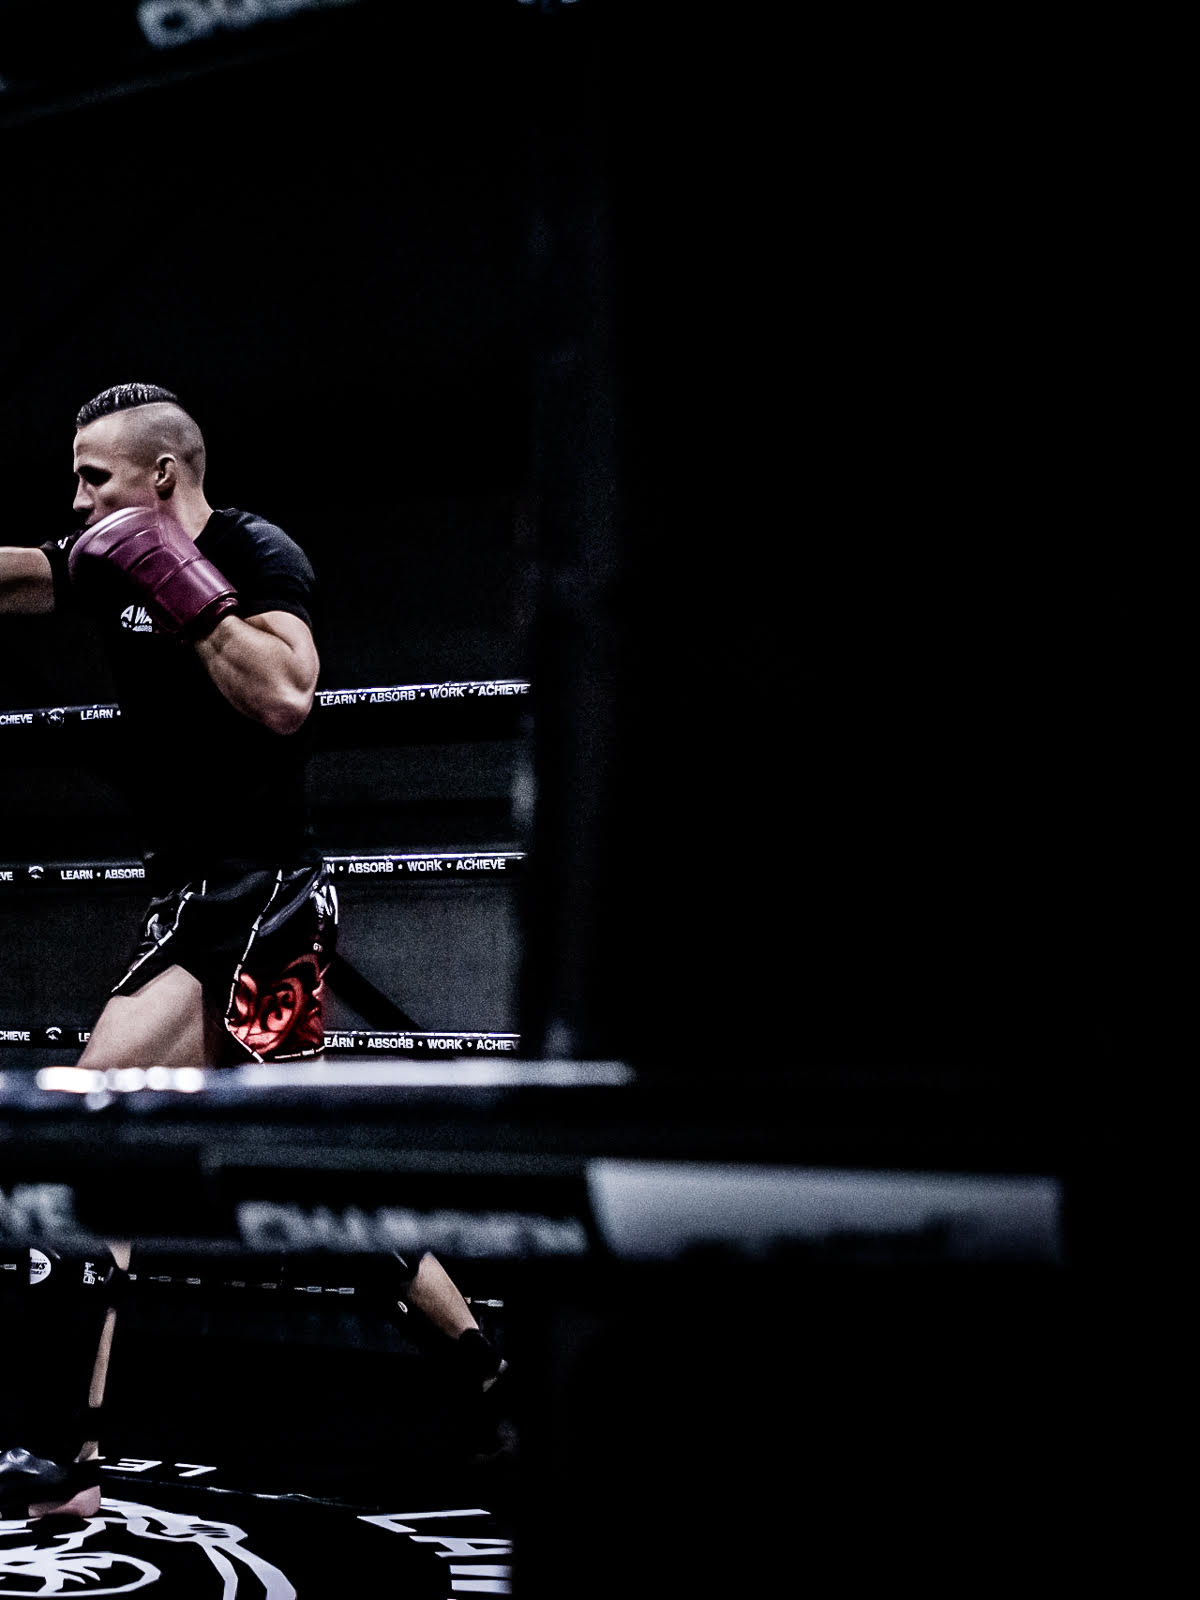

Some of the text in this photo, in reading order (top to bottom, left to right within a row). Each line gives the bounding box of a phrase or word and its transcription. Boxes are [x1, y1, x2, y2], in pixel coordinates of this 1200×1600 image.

[320, 684, 528, 706] LEARN ABSORB WORK ACHIEVE
[81, 709, 113, 720] LEARN
[348, 861, 394, 874] ABSORB
[407, 860, 442, 872] WORK
[456, 859, 506, 871] ACHIEVE
[60, 868, 145, 880] LEARN ABSORB
[324, 1037, 354, 1049] EARN
[367, 1037, 414, 1049] ABSORB
[427, 1038, 462, 1050] WORK
